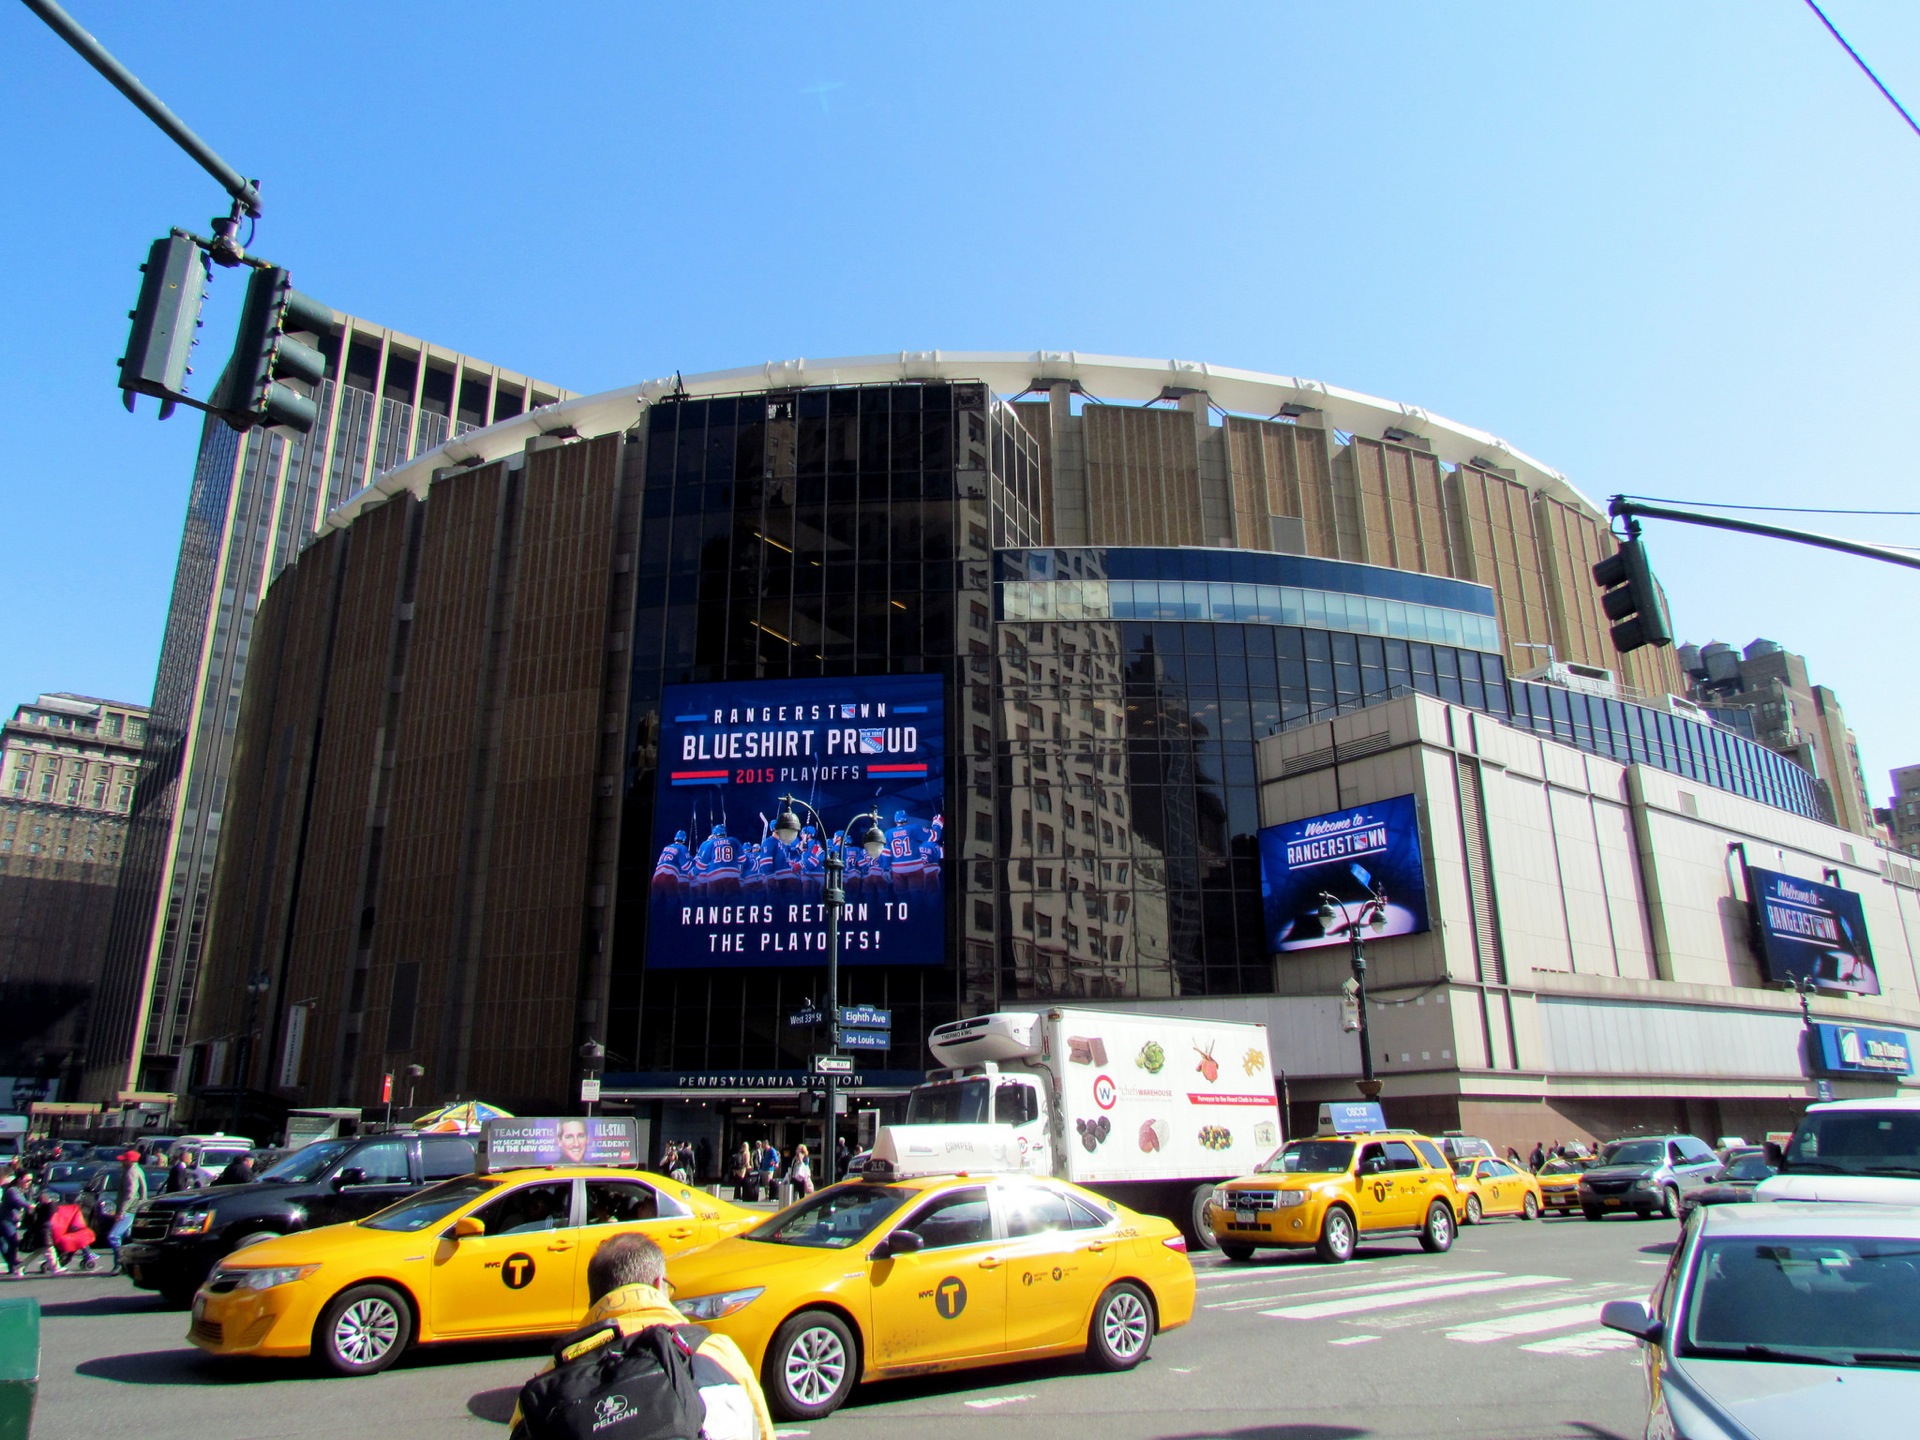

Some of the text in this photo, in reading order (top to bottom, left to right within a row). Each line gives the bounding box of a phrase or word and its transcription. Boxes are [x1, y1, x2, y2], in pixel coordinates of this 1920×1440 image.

[713, 703, 886, 724] RANGERSTWN
[682, 727, 917, 761] BLUESHIRT PRUD
[736, 766, 859, 784] 2015 PLAYOFFS
[1304, 813, 1363, 837] Welcome to
[713, 845, 733, 864] 18
[891, 837, 912, 858] 61
[1287, 828, 1387, 865] RANGERSTWN
[682, 905, 773, 925] RANGERS
[884, 902, 908, 921] TO
[1766, 904, 1838, 941] RANGERSTWN
[709, 931, 880, 952] THE PLAYOFS!
[790, 1016, 805, 1025] West
[816, 1012, 822, 1022] St
[846, 1011, 886, 1024] Eighth Ave
[846, 1035, 857, 1044] Joe
[858, 1035, 875, 1045] Louis
[941, 1029, 973, 1040] THERMO KING
[679, 1075, 863, 1087] PENNSYLVANIA STAION
[494, 1128, 554, 1137] TEAM CURTIS
[506, 1145, 520, 1153] THE
[520, 1145, 537, 1153] NEW
[591, 1140, 631, 1148] ACADEMY
[944, 1141, 974, 1153] CAMPER
[484, 1259, 529, 1286] NYC T
[918, 1283, 960, 1315] NYC T
[592, 1407, 638, 1432] PELICAN
